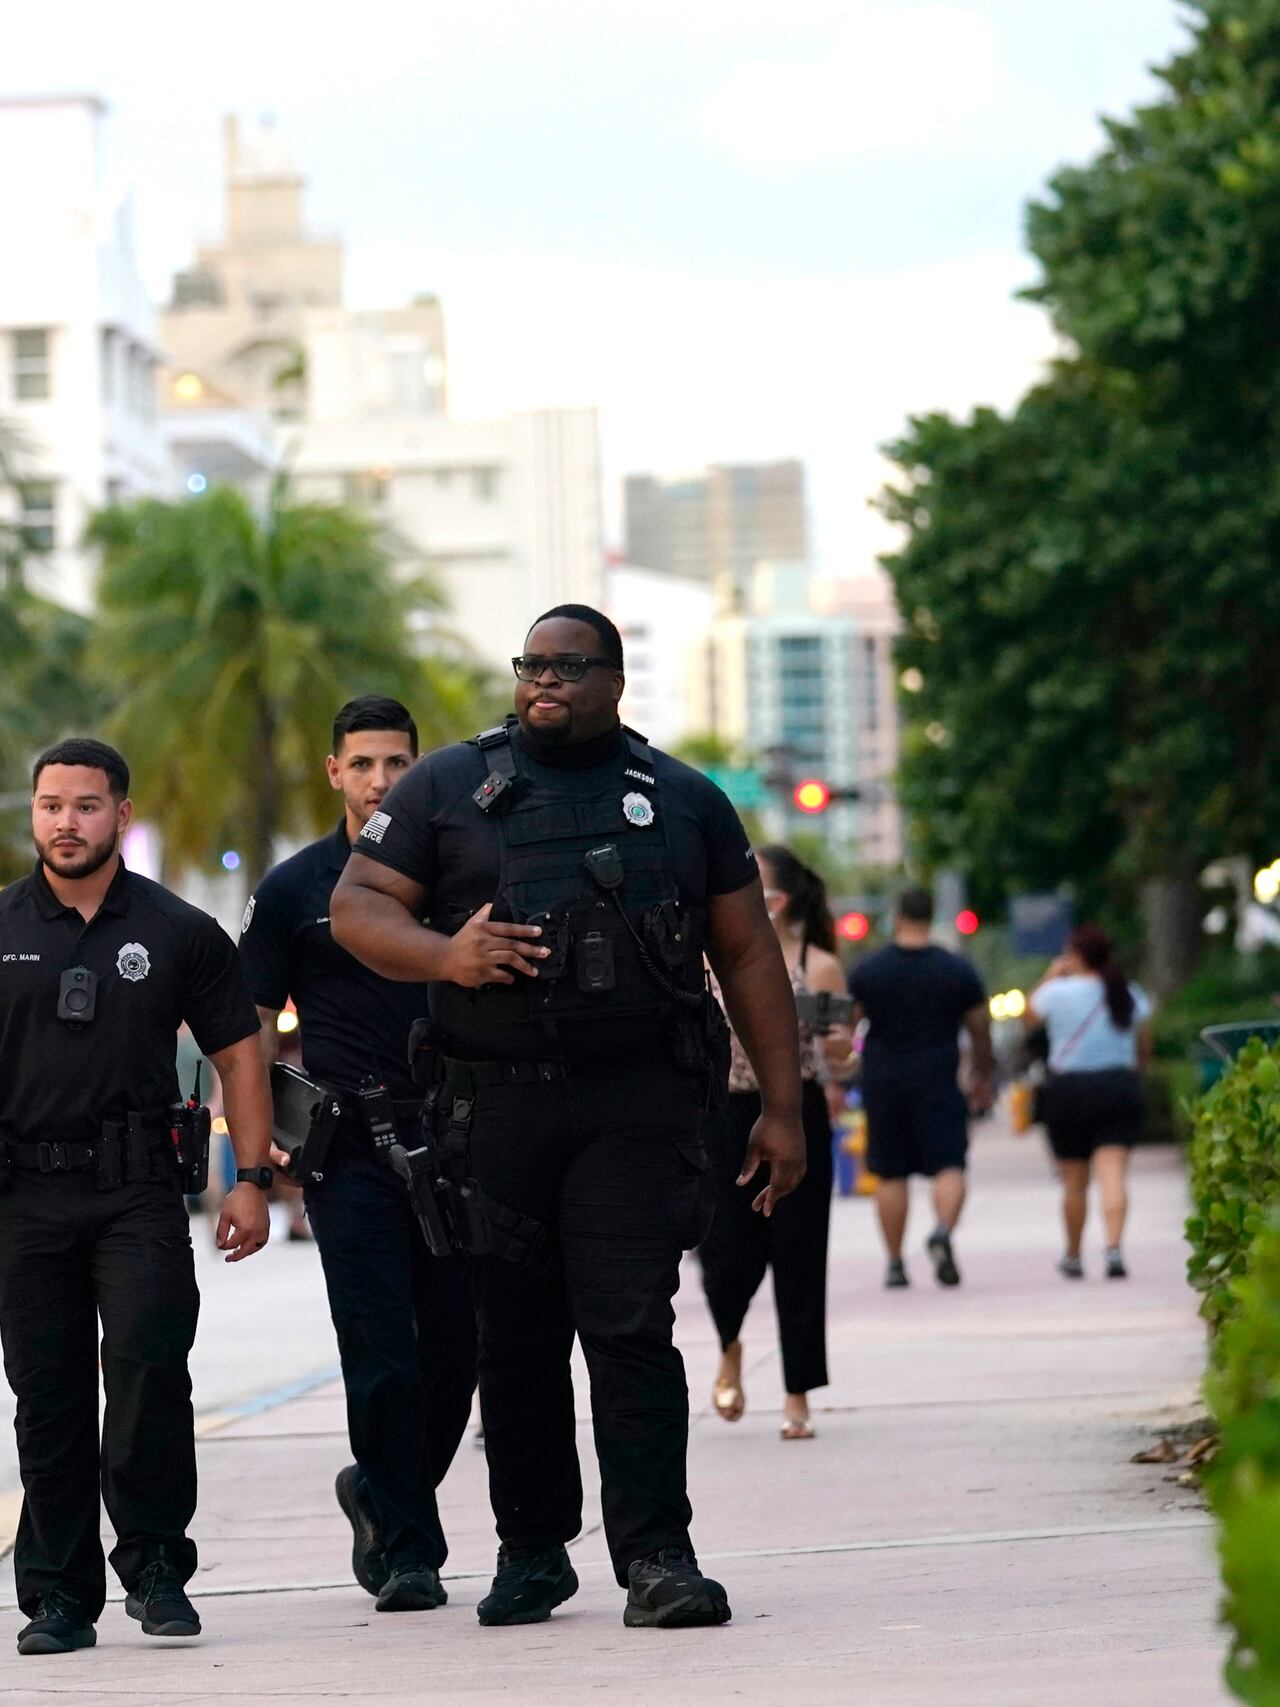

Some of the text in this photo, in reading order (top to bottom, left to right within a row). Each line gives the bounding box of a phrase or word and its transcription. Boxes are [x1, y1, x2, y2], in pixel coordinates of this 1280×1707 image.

[624, 768, 655, 785] JACKSON
[360, 829, 383, 844] OLICE
[2, 953, 40, 962] OFC. MARIN
